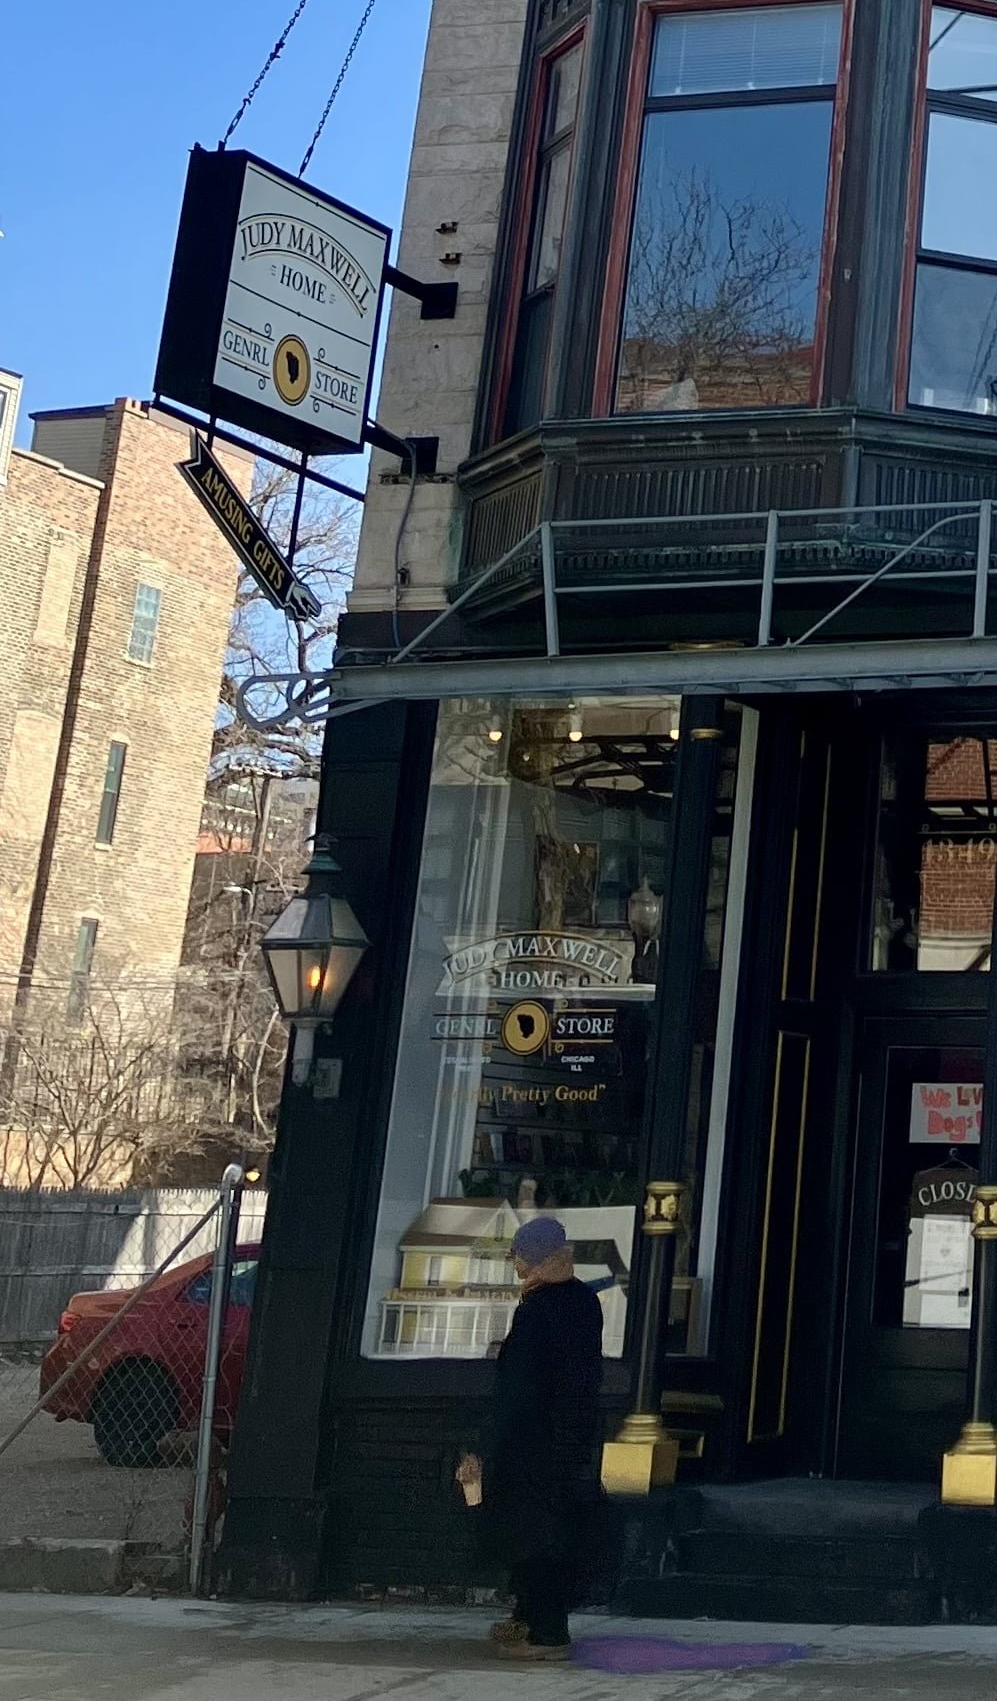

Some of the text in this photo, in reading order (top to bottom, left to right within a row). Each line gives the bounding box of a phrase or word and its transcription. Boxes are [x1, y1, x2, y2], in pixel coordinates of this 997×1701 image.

[241, 220, 374, 313] JUDY MAXWELL
[279, 264, 327, 304] HOME
[223, 330, 358, 405] GENRL STORE
[201, 467, 285, 590] AMUSING GIFTS
[505, 936, 622, 979] MAXWELL
[500, 970, 563, 989] HOME
[556, 1017, 615, 1036] STORE
[561, 1056, 595, 1064] CHICAGO
[501, 1084, 550, 1106] Pretty
[919, 1085, 952, 1108] We
[917, 1180, 978, 1206] CLOSE
